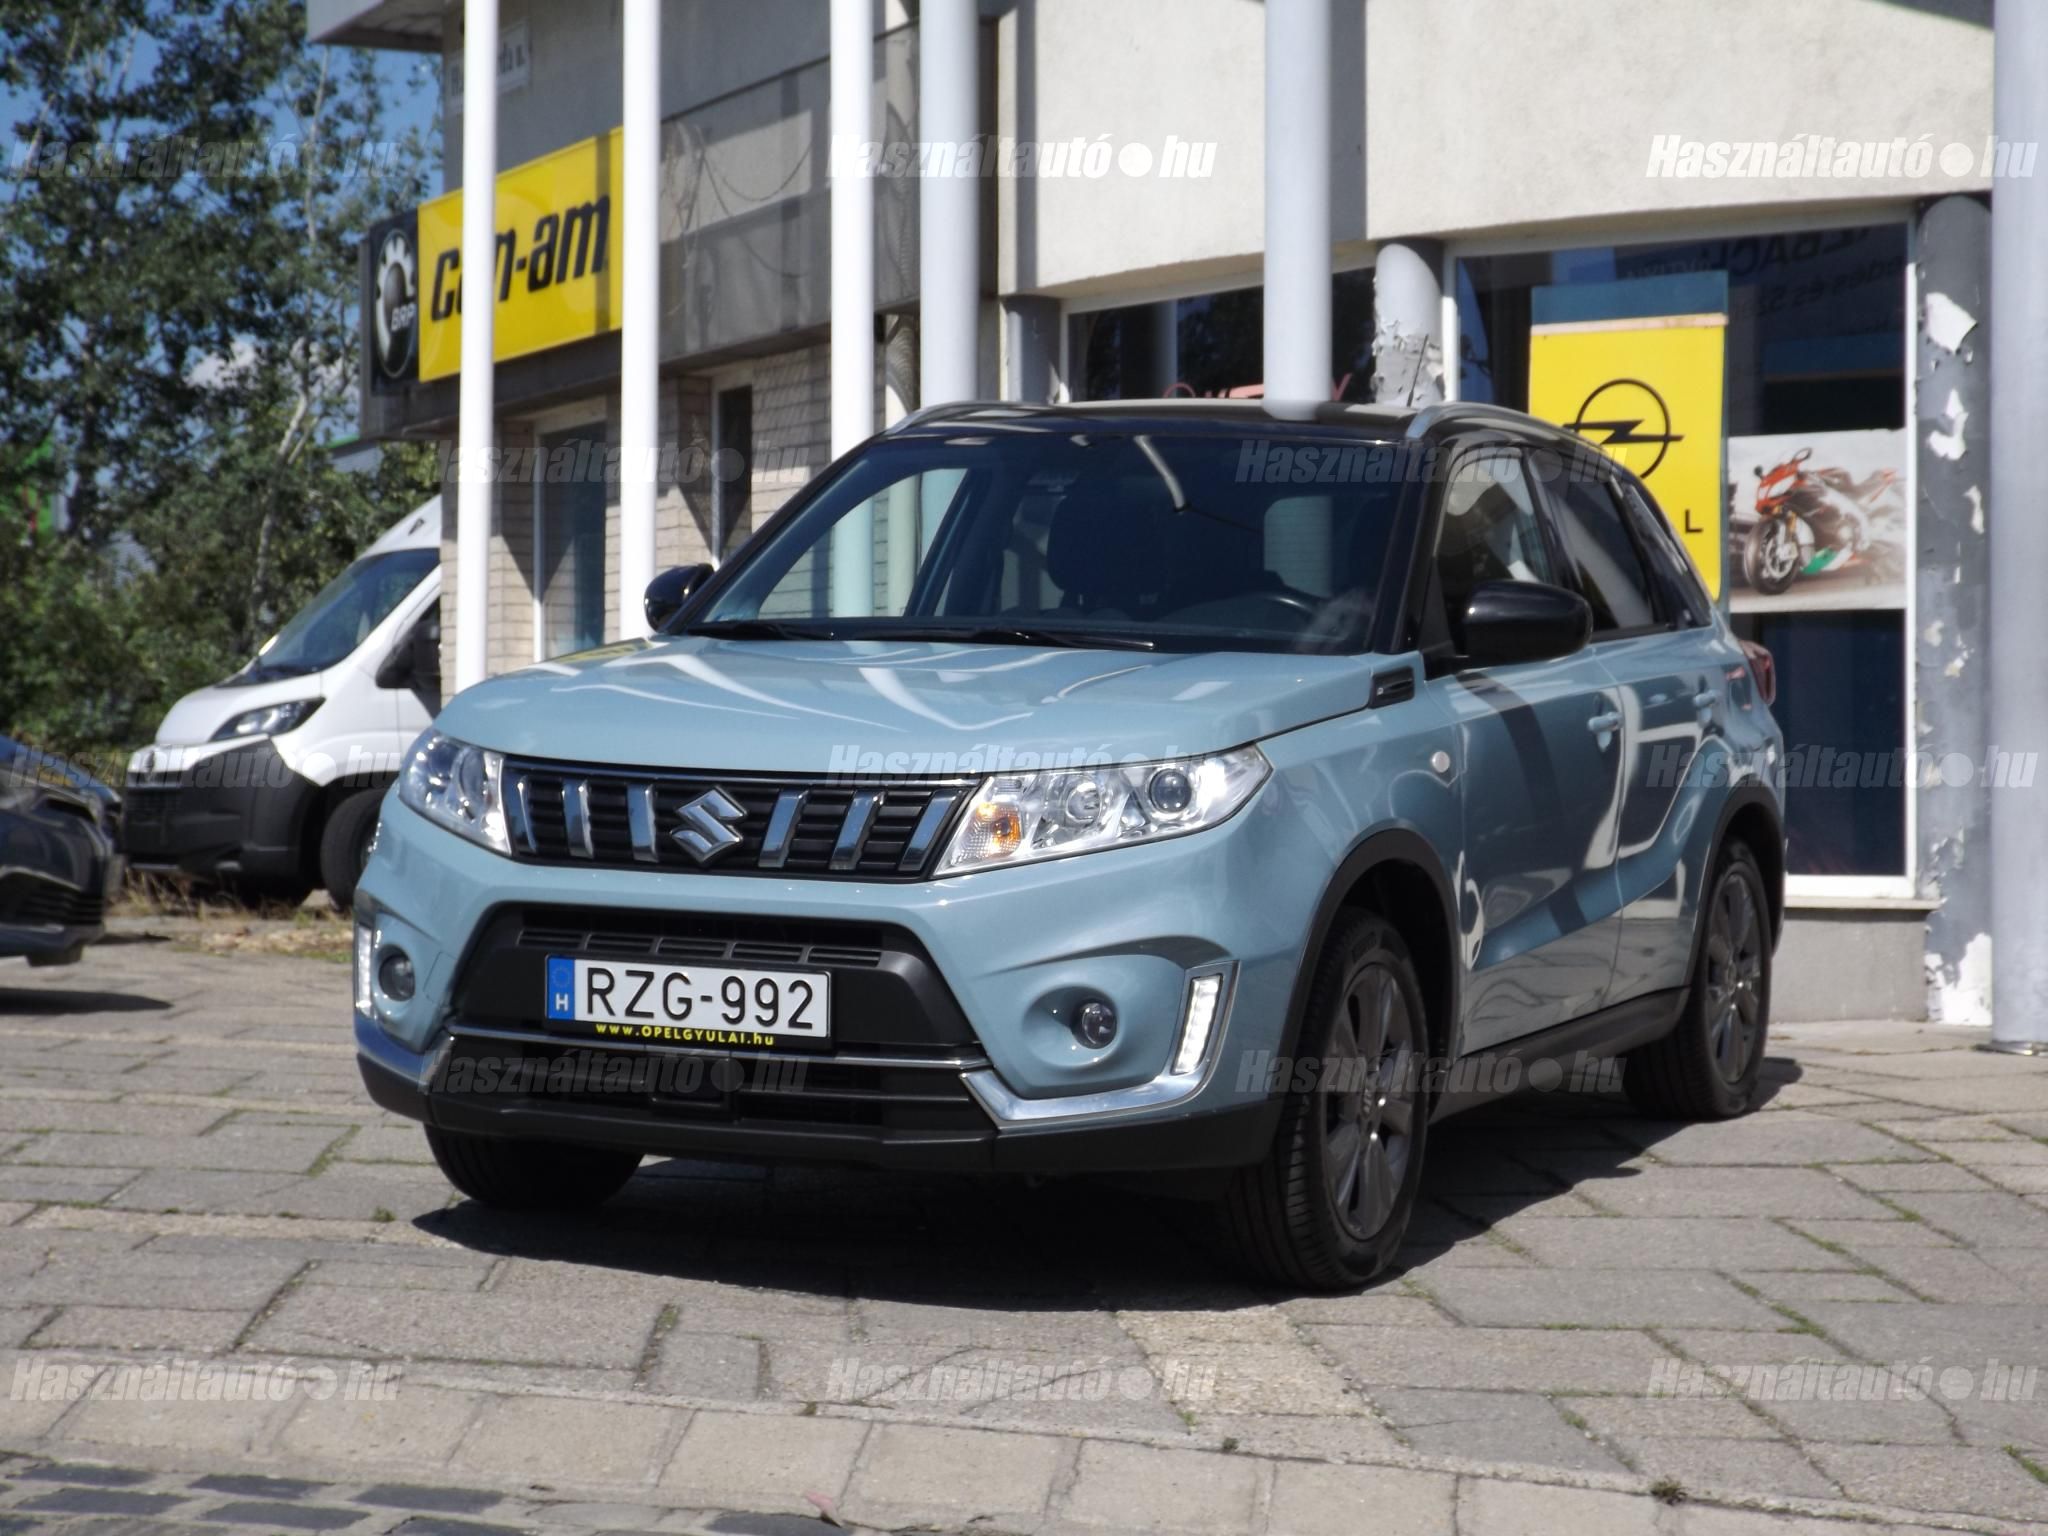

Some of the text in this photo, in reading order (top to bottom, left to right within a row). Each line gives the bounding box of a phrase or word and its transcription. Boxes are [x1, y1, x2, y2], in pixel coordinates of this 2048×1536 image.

[391, 303, 416, 332] BRP
[555, 993, 569, 1011] H
[586, 967, 814, 1030] RZG-992
[596, 1023, 774, 1046] www.OPELGYULAI.hu
